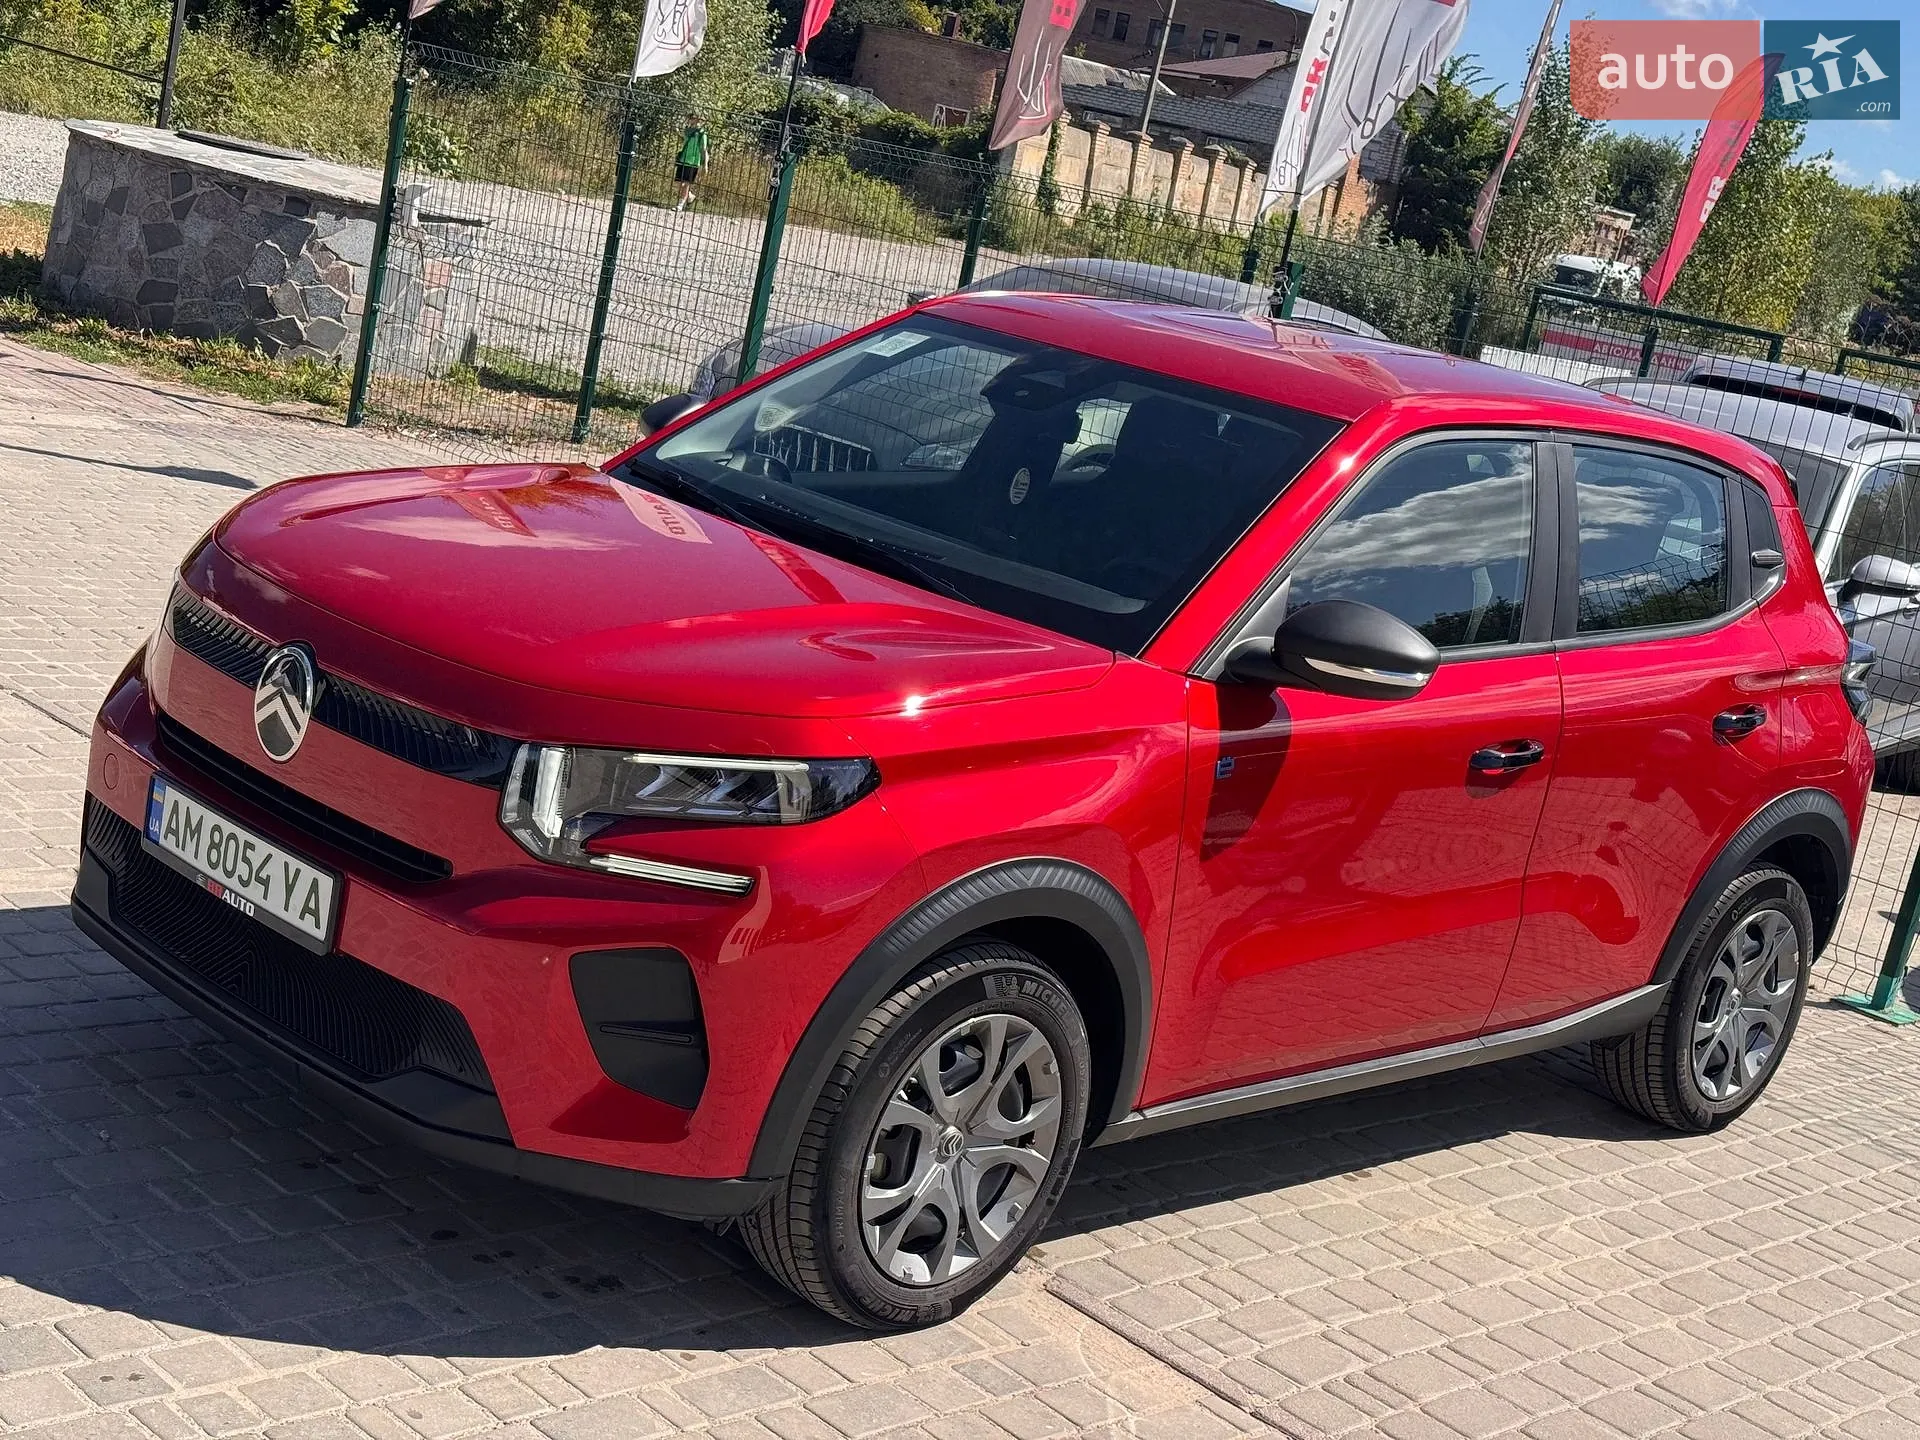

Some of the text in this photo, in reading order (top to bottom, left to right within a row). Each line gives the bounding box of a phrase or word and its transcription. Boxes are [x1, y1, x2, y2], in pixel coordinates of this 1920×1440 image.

[149, 817, 161, 834] UA
[163, 798, 204, 860] AM
[206, 823, 273, 902] 8054
[283, 861, 321, 930] YA
[221, 888, 255, 917] AUTO
